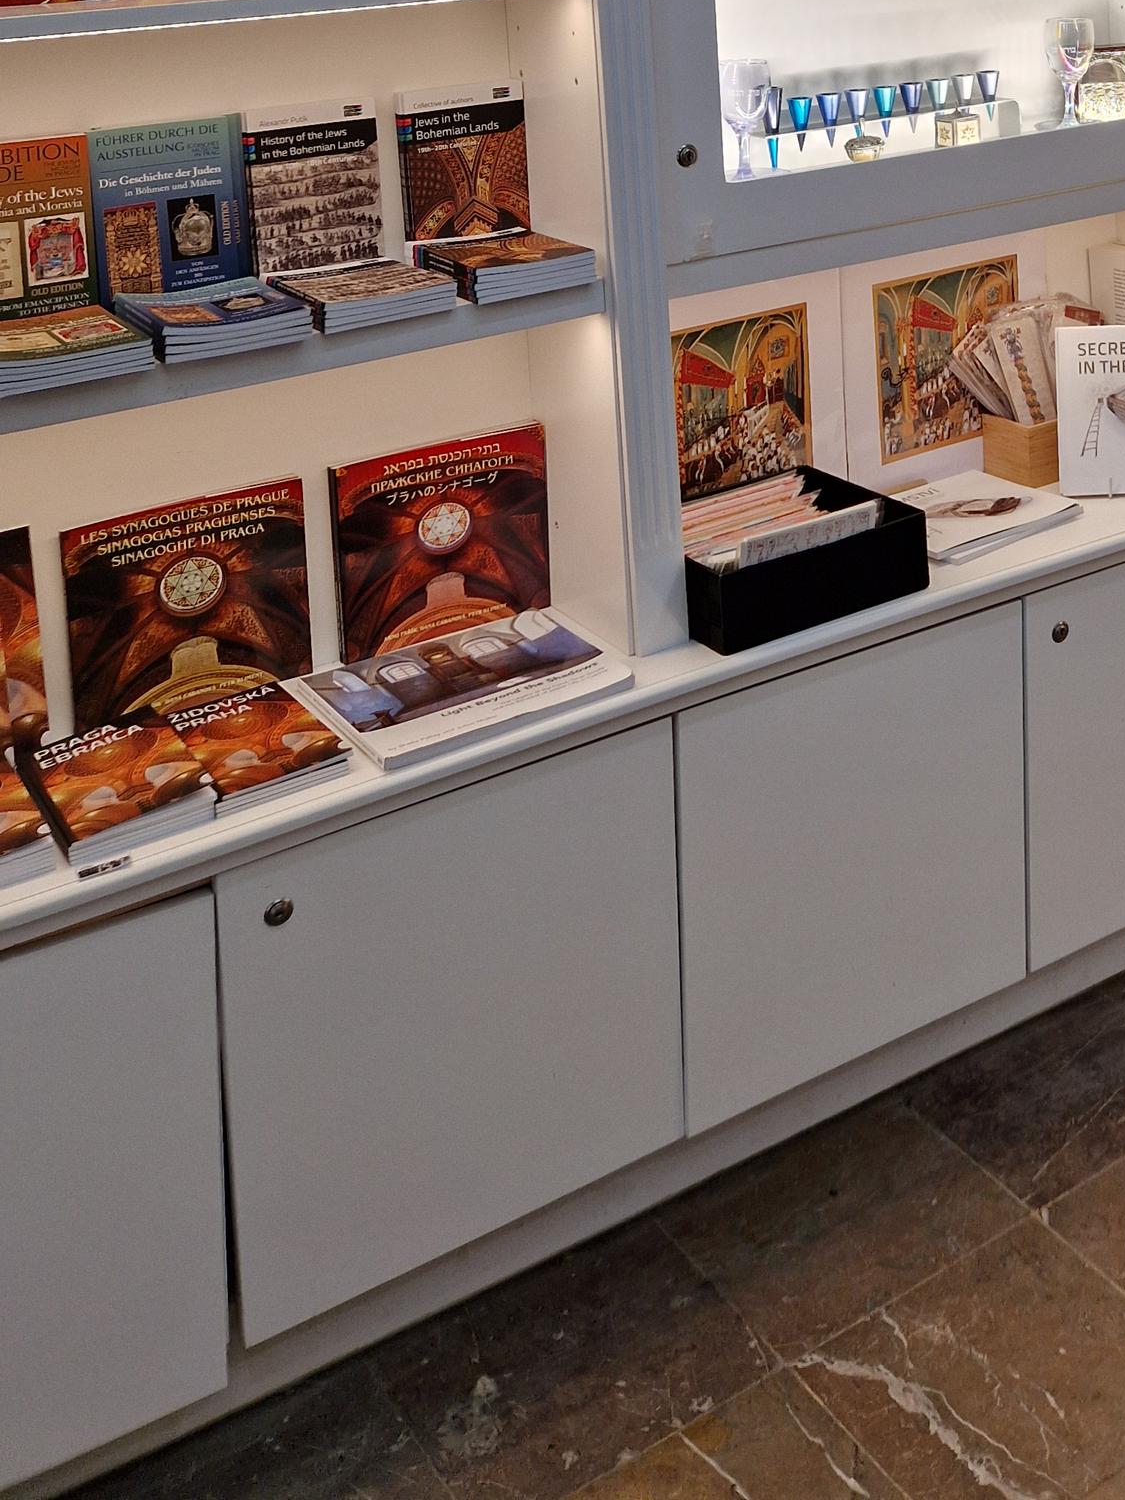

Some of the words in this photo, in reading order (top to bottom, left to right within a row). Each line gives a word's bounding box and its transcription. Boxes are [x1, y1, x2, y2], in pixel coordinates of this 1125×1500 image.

[415, 117, 440, 128] Jews
[441, 114, 451, 123] in
[453, 111, 470, 122] the
[415, 125, 468, 140] Bohemian
[469, 120, 500, 133] Lands
[96, 132, 145, 147] FÜHRER
[148, 127, 194, 140] DURCH
[198, 123, 220, 135] DIE
[260, 135, 295, 147] History
[296, 133, 306, 142] of
[307, 131, 324, 141] the
[325, 128, 348, 139] Jews
[1, 141, 79, 165] BITION
[97, 141, 185, 162] AUSSTELLUNG
[261, 150, 271, 160] in
[272, 148, 288, 159] the
[289, 143, 336, 156] Bohemian
[338, 139, 366, 150] Lands
[98, 179, 117, 189] Die
[119, 171, 174, 185] Geschichte
[175, 168, 192, 178] der
[192, 165, 222, 178] Juden
[124, 188, 134, 197] in
[135, 185, 170, 197] Böhmen
[172, 182, 188, 191] und
[190, 178, 223, 189] Mähren
[7, 191, 23, 204] of
[24, 189, 47, 202] the
[49, 186, 84, 199] Jews
[16, 204, 36, 215] and
[38, 199, 83, 212] Moravia
[24, 292, 91, 309] EMANCIPATION
[31, 287, 49, 296] OLD
[50, 281, 85, 294] EDITION
[32, 306, 50, 314] THE
[52, 300, 90, 311] PRESENT
[1078, 361, 1095, 374] IN
[371, 468, 442, 494] ПРАЖСКИЕ
[445, 455, 514, 477] СИНАГОГИ
[386, 471, 499, 506] プラハのシナゴーグ
[79, 528, 107, 546] LES
[111, 505, 209, 536] SYNAGOGUES
[212, 500, 233, 514] DE
[236, 488, 290, 508] PRAGUE
[97, 527, 181, 556] SINAGOGAS
[185, 505, 276, 535] PRAGUENSES
[111, 538, 197, 568] SINAGOGHE
[200, 533, 216, 546] DI
[219, 522, 265, 542] PRAGA
[441, 703, 472, 717] Light
[476, 688, 521, 706] Beyond
[524, 681, 545, 691] the
[546, 661, 599, 684] Shadows
[168, 685, 276, 724] ŽIDOVSKÁ
[175, 704, 253, 732] PRAHA
[33, 724, 118, 761] PRAGA
[39, 724, 144, 770] EBRAICA
